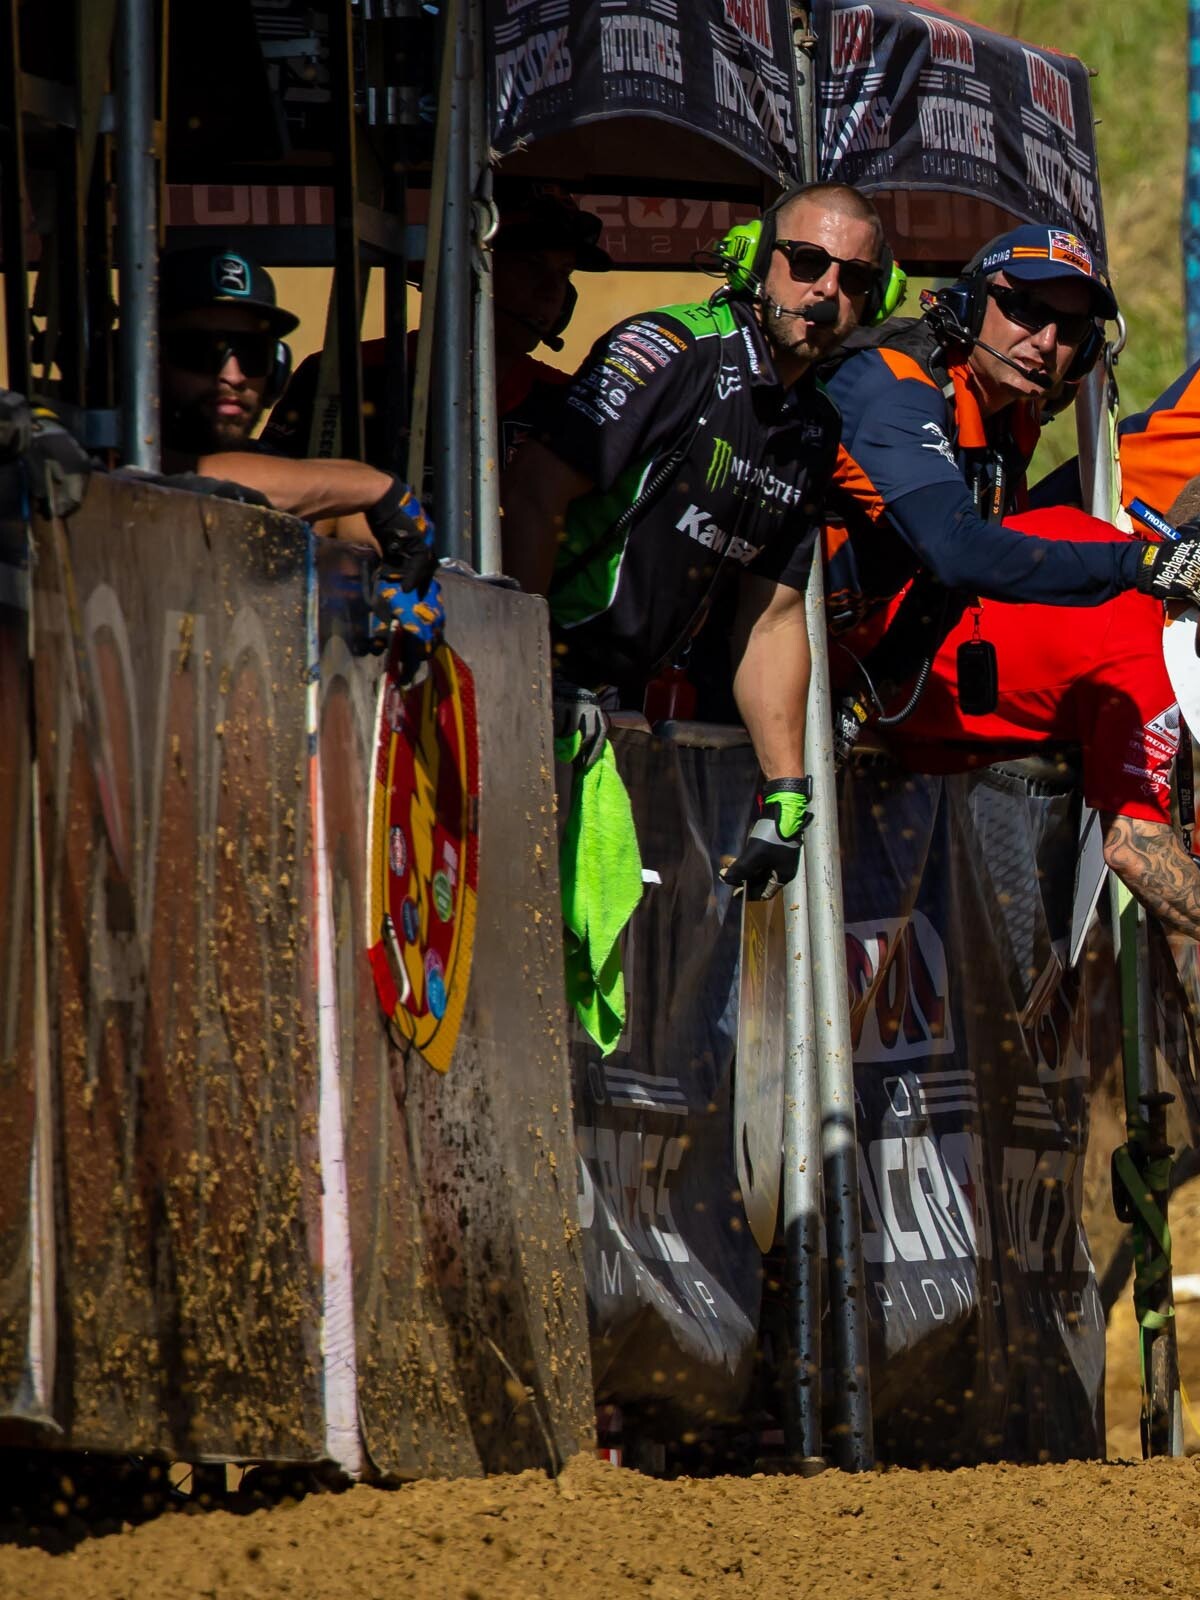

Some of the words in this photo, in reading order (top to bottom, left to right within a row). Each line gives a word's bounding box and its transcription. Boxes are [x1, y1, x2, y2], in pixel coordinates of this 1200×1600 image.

[983, 249, 1011, 269] RACING
[625, 324, 680, 354] DUNLOP
[1143, 510, 1178, 540] TROXELL
[1153, 541, 1194, 589] Mechanix
[1144, 735, 1176, 755] DUNL
